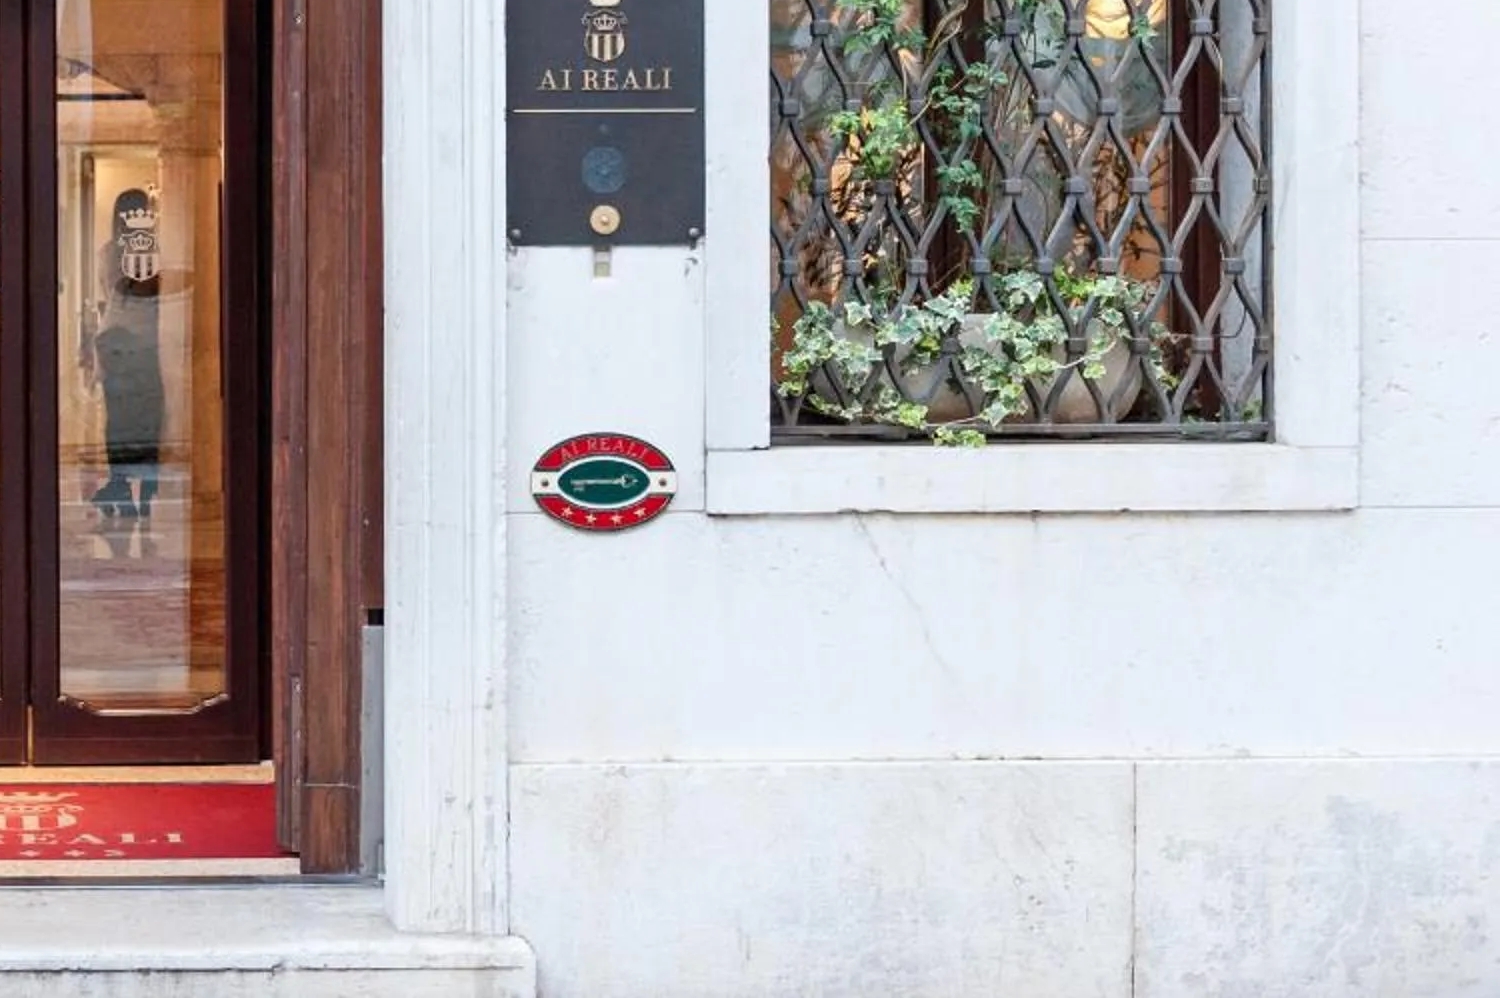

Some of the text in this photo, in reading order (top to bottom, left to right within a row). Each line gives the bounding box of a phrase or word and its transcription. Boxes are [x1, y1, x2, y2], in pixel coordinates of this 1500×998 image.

[537, 68, 672, 92] AI REALI
[560, 437, 648, 459] AI REALI
